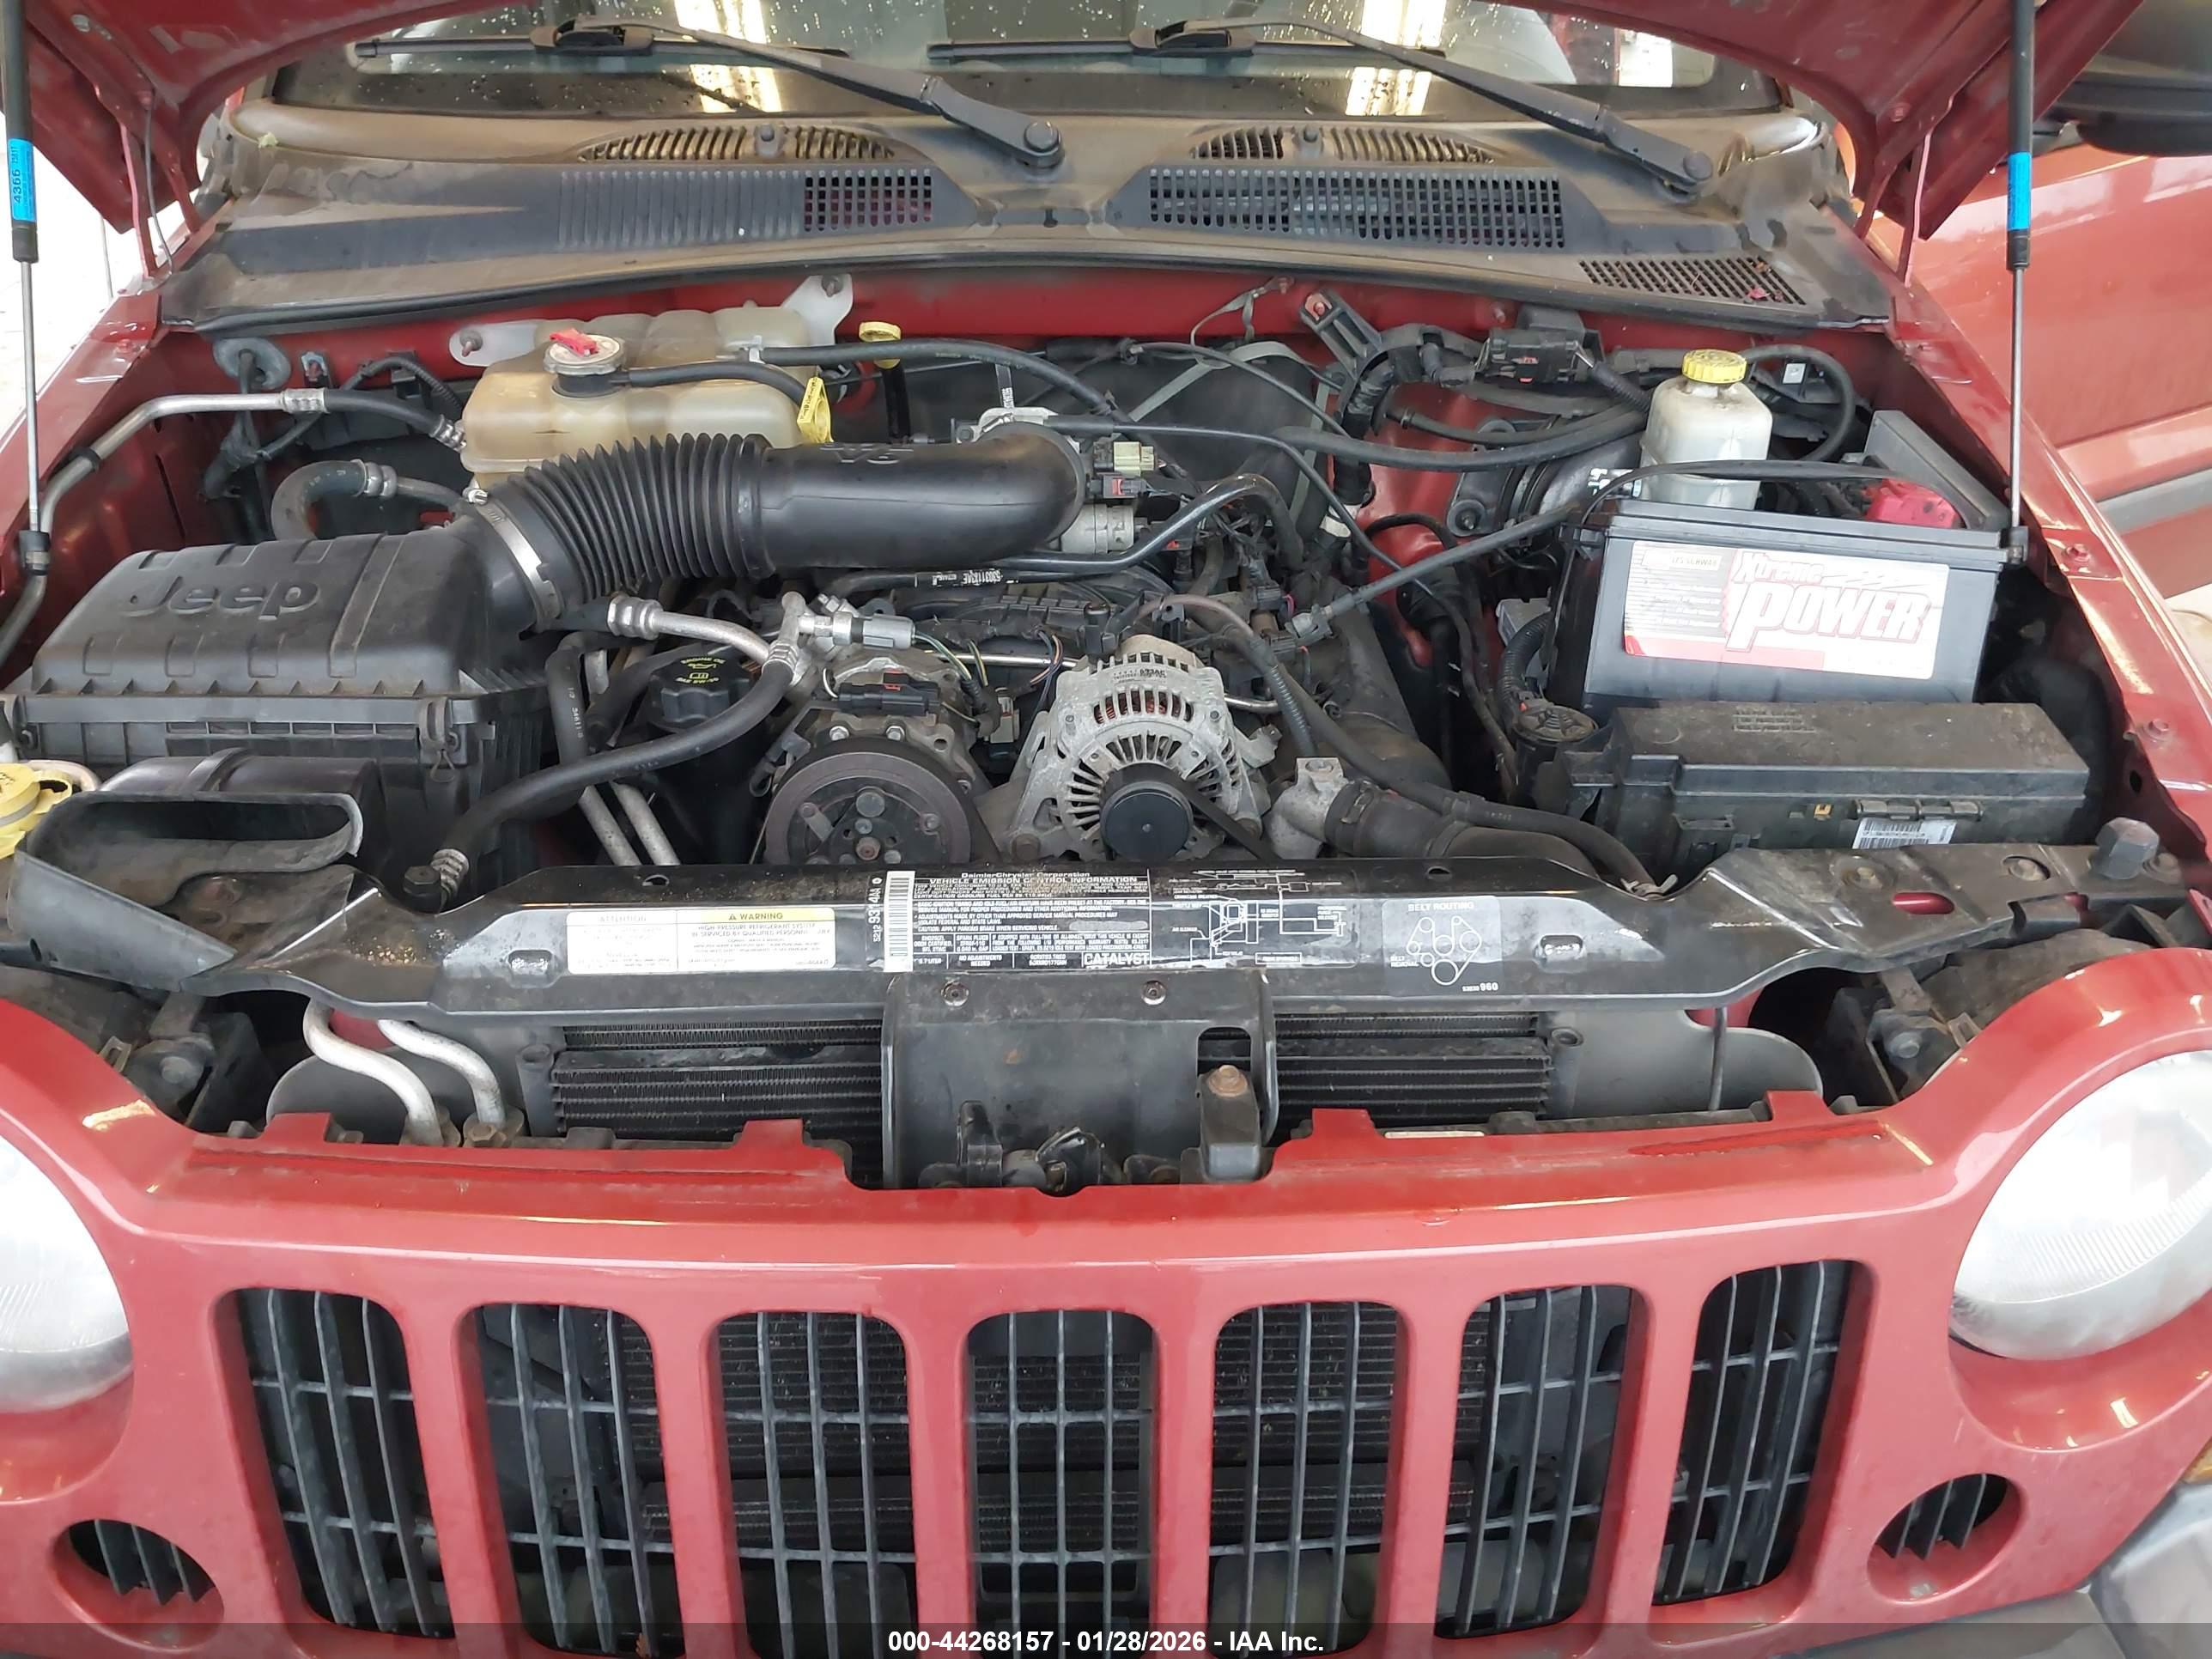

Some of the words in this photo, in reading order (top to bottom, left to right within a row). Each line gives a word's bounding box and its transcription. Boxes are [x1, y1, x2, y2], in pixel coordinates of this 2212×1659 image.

[12, 169, 21, 204] 4366
[119, 575, 321, 620] Jeep
[1724, 581, 1932, 653] POWER
[739, 912, 783, 921] WARNING
[1407, 903, 1431, 912] BELT
[1433, 901, 1474, 910] ROUTING
[1084, 953, 1149, 965] CATALYST
